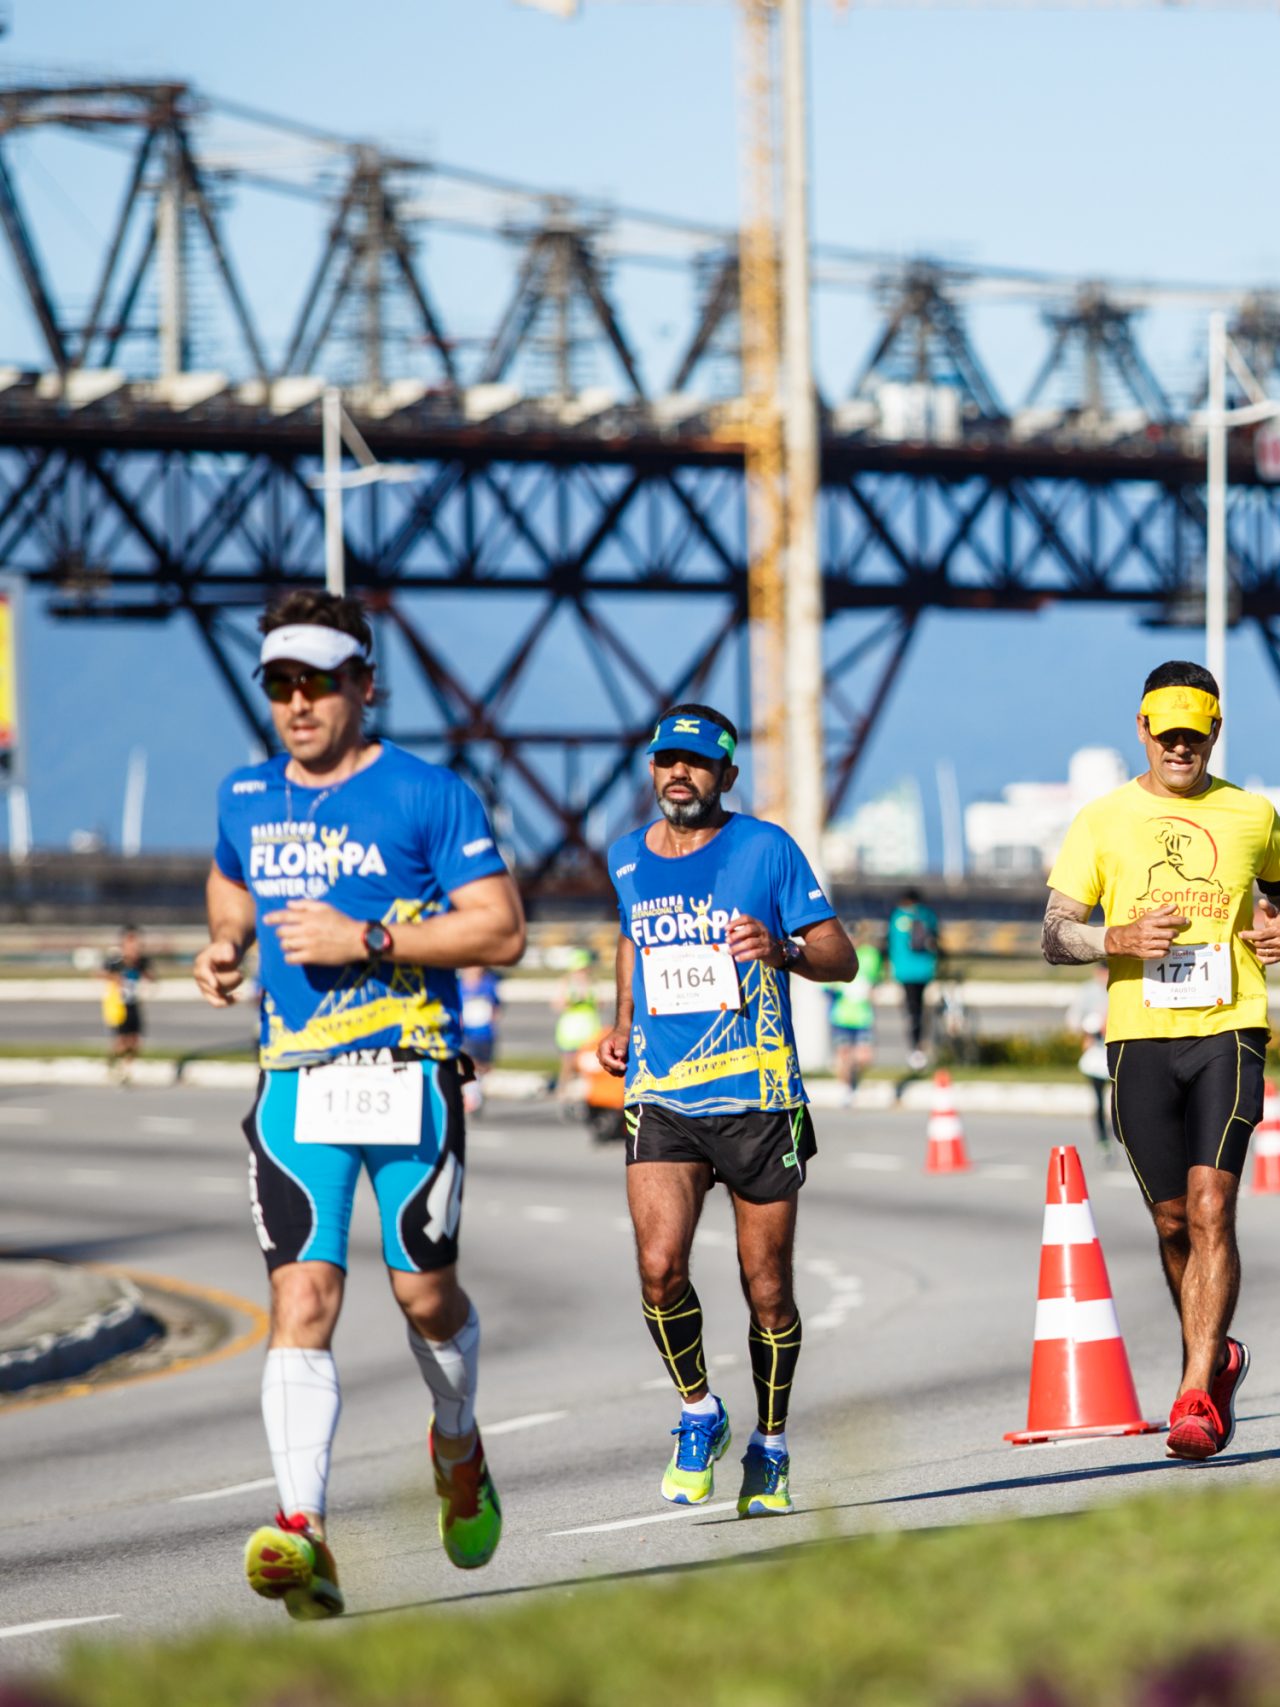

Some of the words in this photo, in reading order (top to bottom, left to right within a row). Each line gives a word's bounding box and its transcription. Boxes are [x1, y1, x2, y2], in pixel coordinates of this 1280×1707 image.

[632, 893, 684, 914] MARATONA
[1151, 888, 1230, 905] Confraria
[660, 965, 716, 989] 1164
[1156, 961, 1210, 983] 1771
[324, 1089, 391, 1115] 1183
